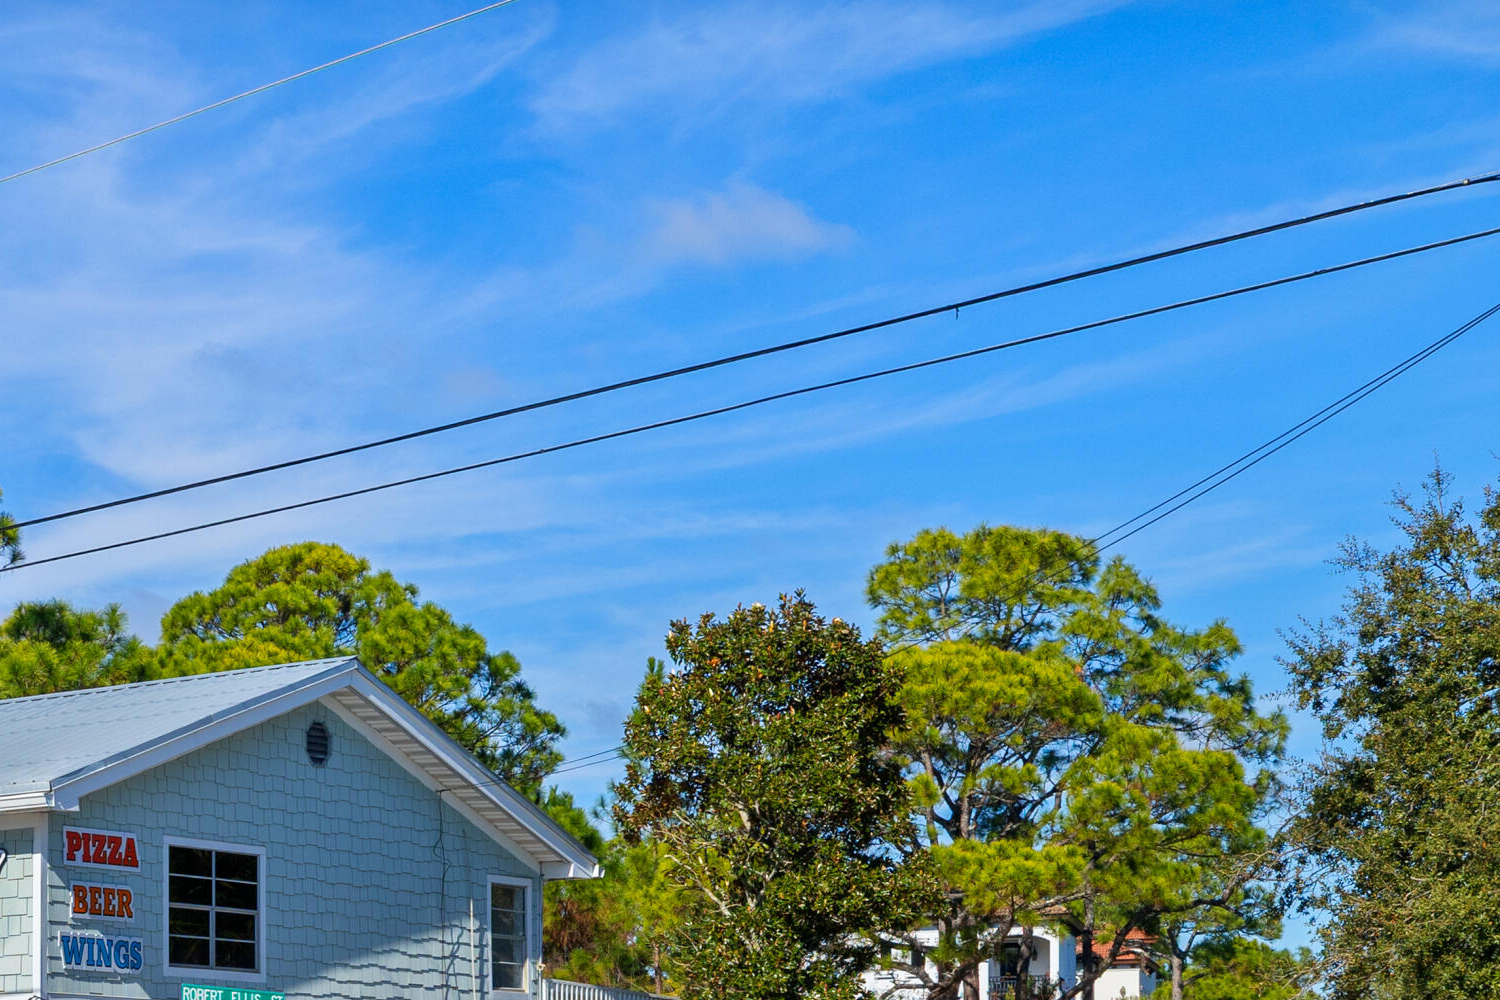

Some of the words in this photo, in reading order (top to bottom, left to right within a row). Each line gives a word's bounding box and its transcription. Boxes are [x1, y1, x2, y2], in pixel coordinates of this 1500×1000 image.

[66, 830, 139, 868] PIZZA
[73, 884, 134, 919] BEER
[61, 935, 143, 970] WINGS
